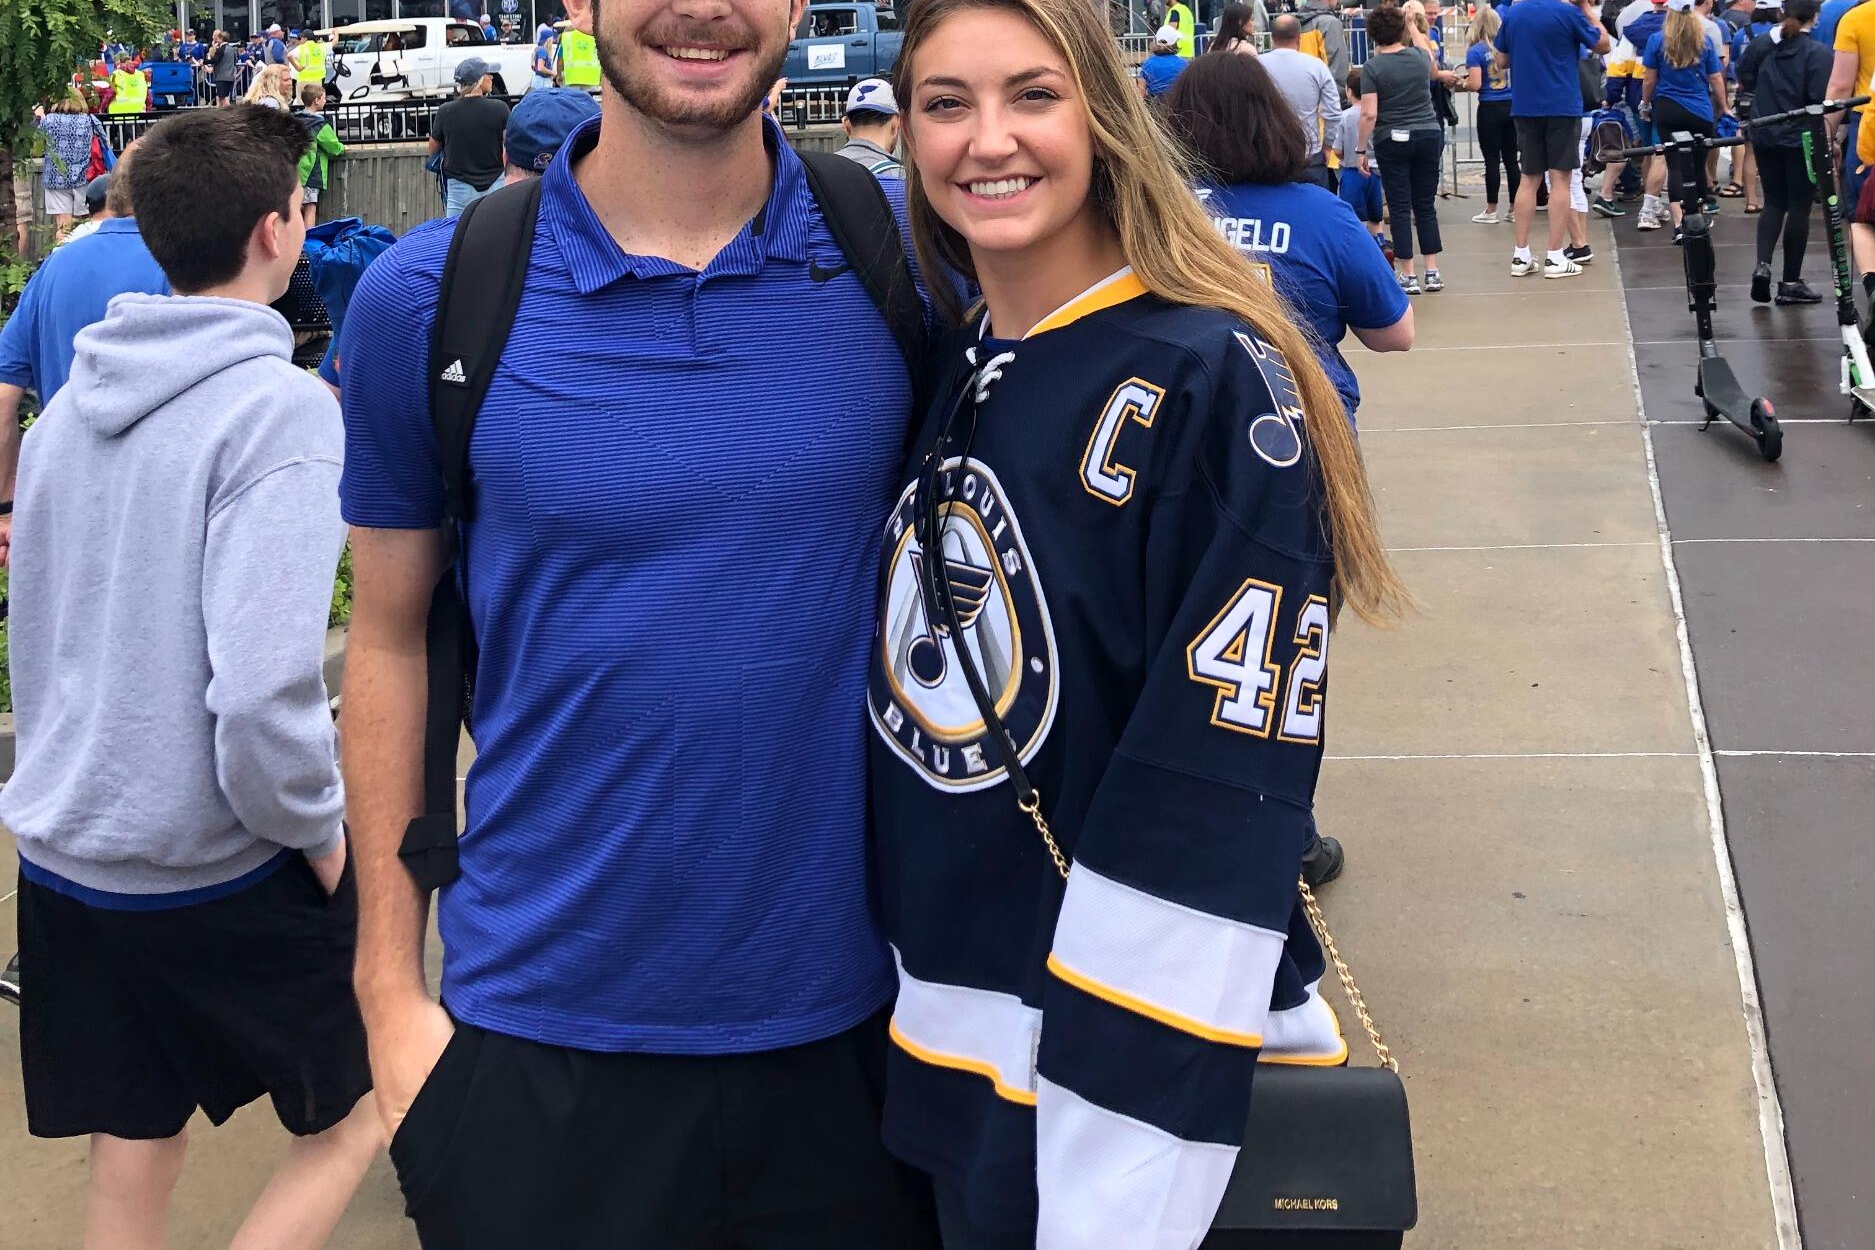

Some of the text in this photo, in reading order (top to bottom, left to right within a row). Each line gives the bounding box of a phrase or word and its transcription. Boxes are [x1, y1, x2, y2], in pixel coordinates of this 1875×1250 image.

[1079, 376, 1166, 506] C
[1186, 578, 1329, 747] 42
[1274, 1198, 1338, 1210] MICHAEL KORS
